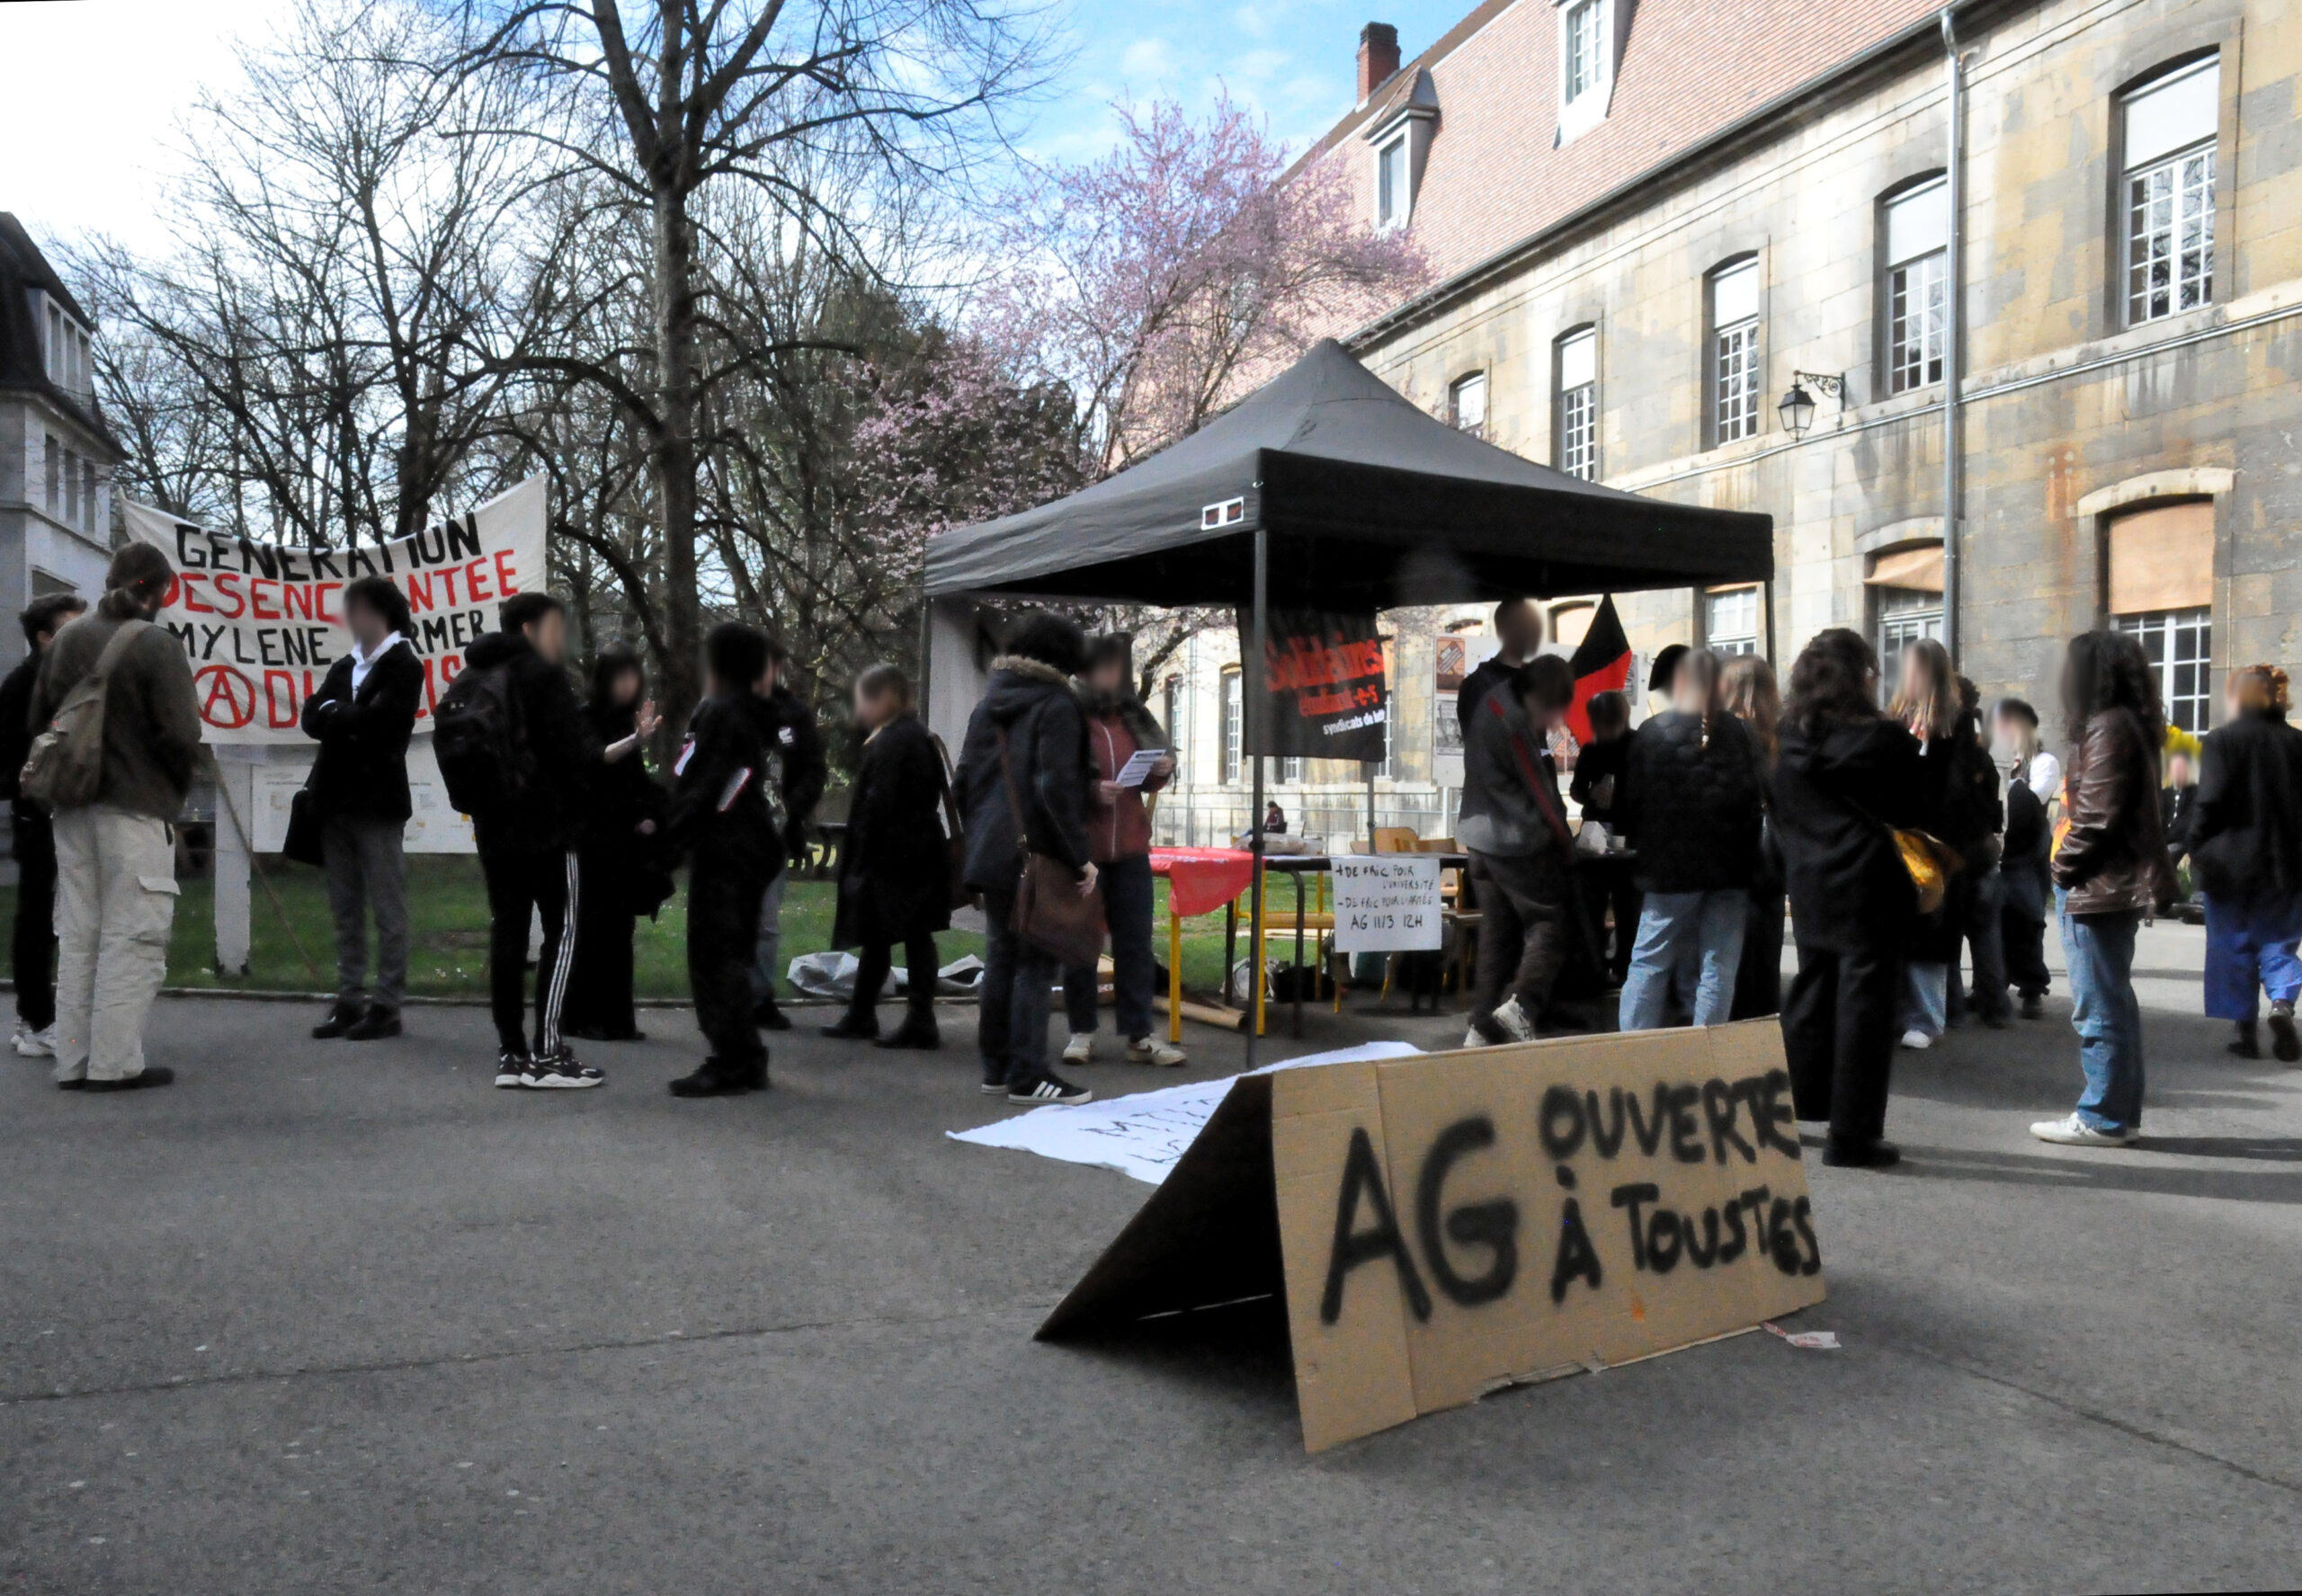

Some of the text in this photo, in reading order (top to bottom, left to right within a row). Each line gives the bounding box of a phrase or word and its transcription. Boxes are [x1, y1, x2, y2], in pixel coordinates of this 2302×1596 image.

[168, 621, 332, 665] MYLENE
[1351, 914, 1368, 930] AG
[1403, 914, 1423, 929] 12H
[1538, 1067, 1802, 1164] OUVERTE
[1319, 1115, 1520, 1326] AG
